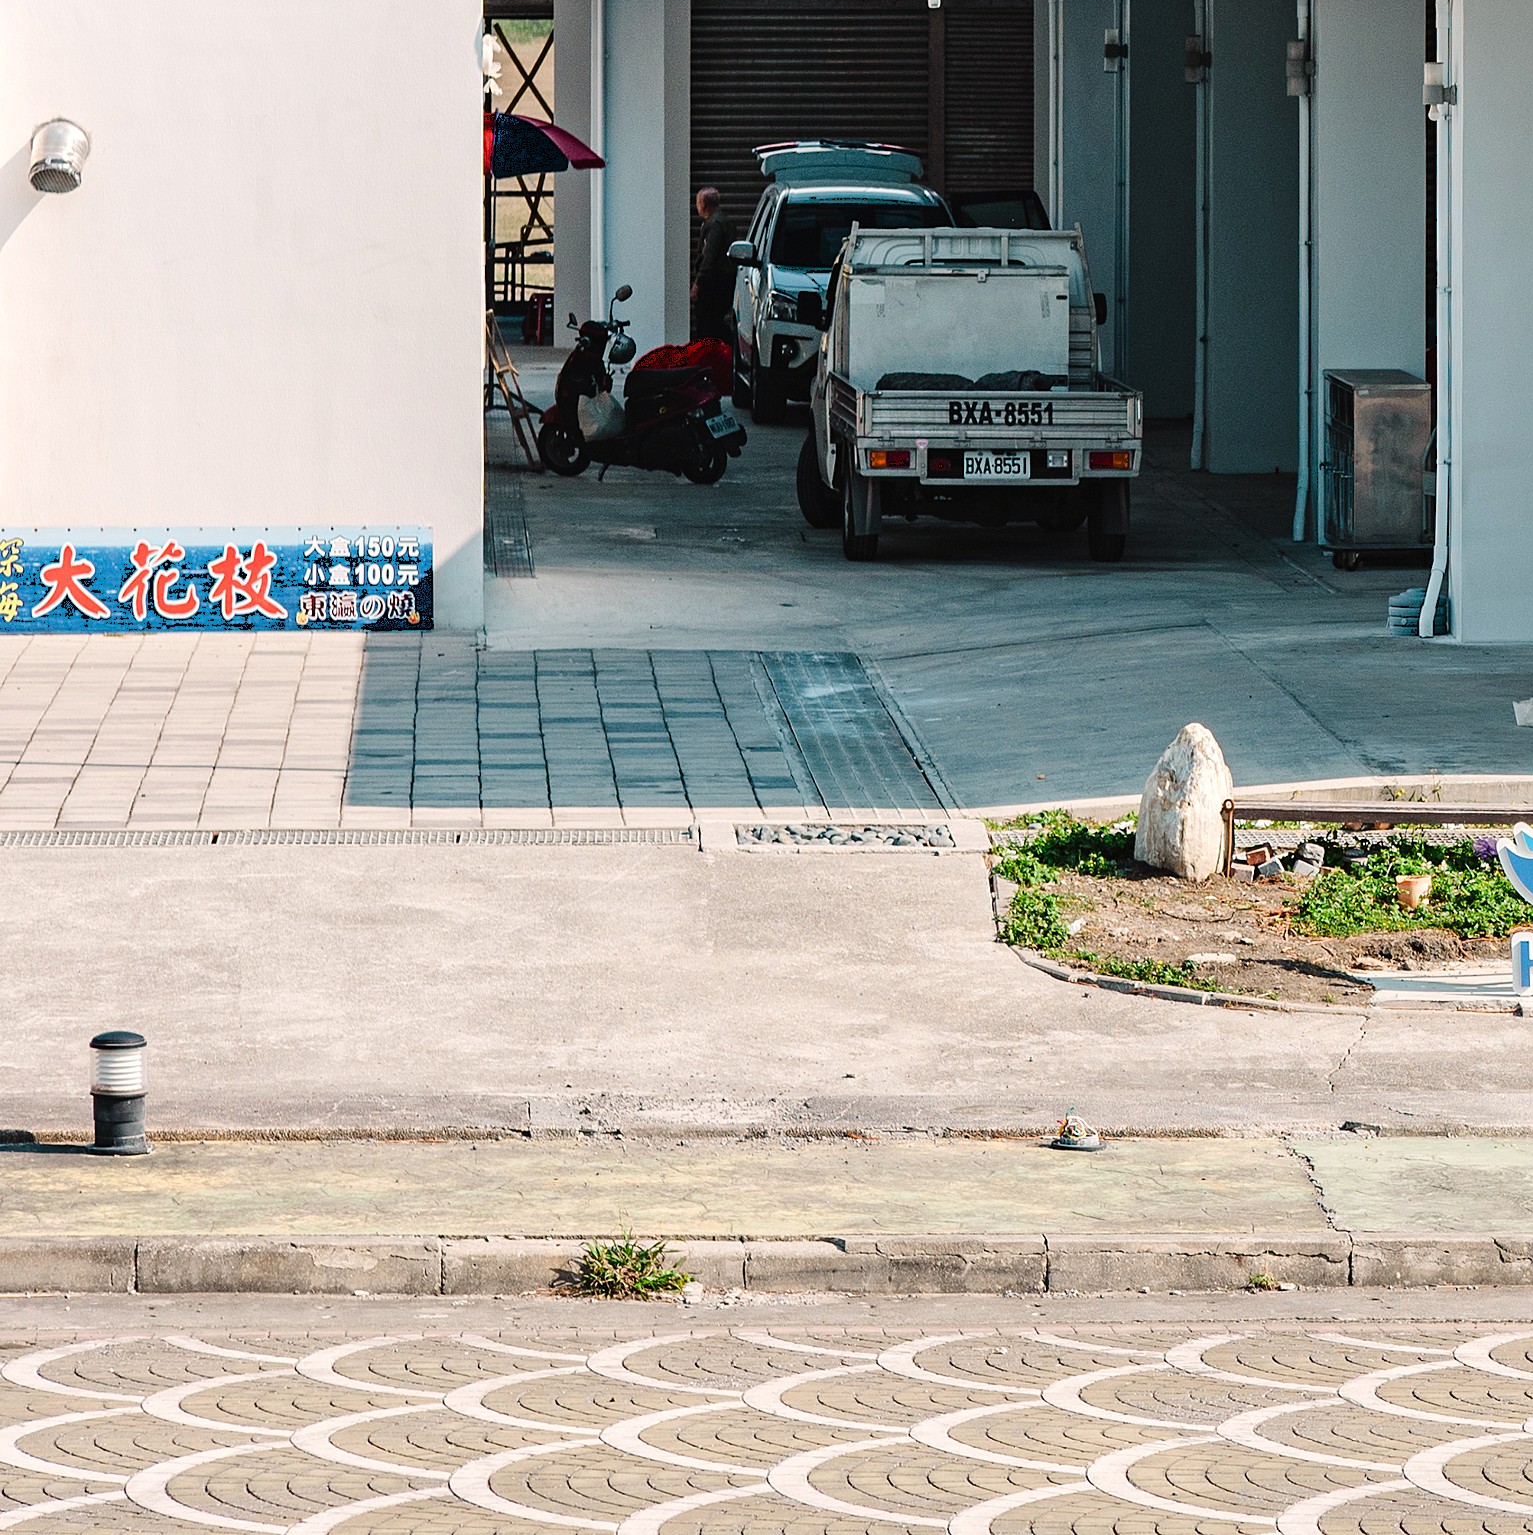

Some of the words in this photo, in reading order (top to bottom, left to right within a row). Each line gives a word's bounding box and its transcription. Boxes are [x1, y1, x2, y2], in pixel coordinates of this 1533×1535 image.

[949, 401, 1054, 426] BXA-8551
[965, 457, 1027, 475] BXA-8551
[303, 535, 420, 558] 大盒150元
[32, 540, 288, 620] 大花枝
[303, 563, 420, 585] 小盒100元
